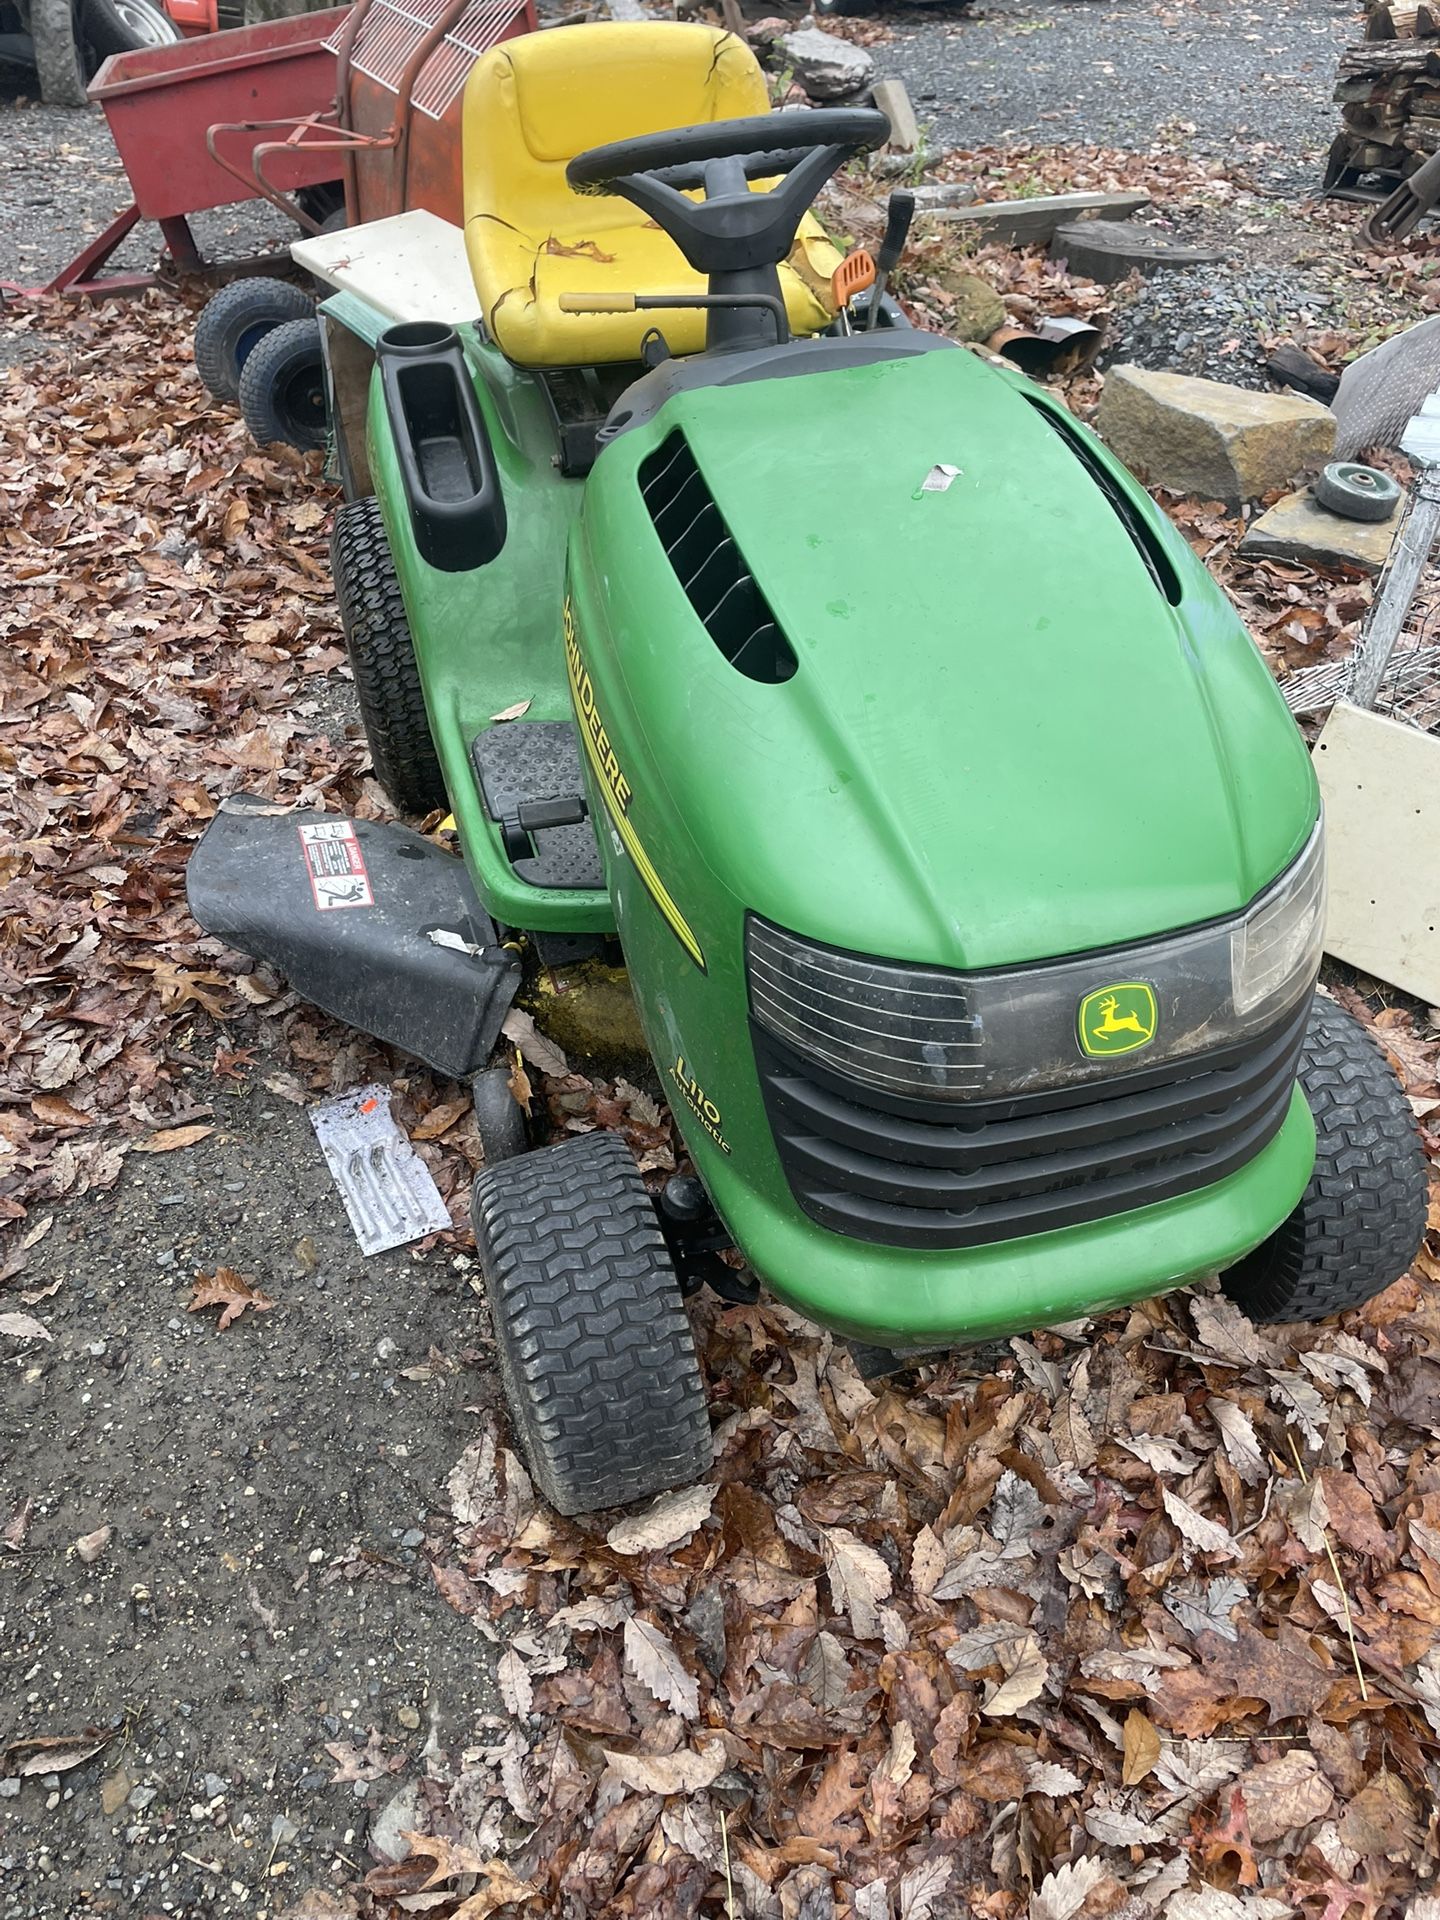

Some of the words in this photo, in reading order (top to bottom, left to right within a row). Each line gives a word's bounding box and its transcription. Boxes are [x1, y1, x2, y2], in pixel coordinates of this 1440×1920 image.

[564, 594, 584, 683] JOHN
[580, 672, 632, 811] DEERE
[348, 846, 362, 870] DANGER
[668, 1067, 730, 1153] Automatic
[676, 1055, 721, 1124] L110
